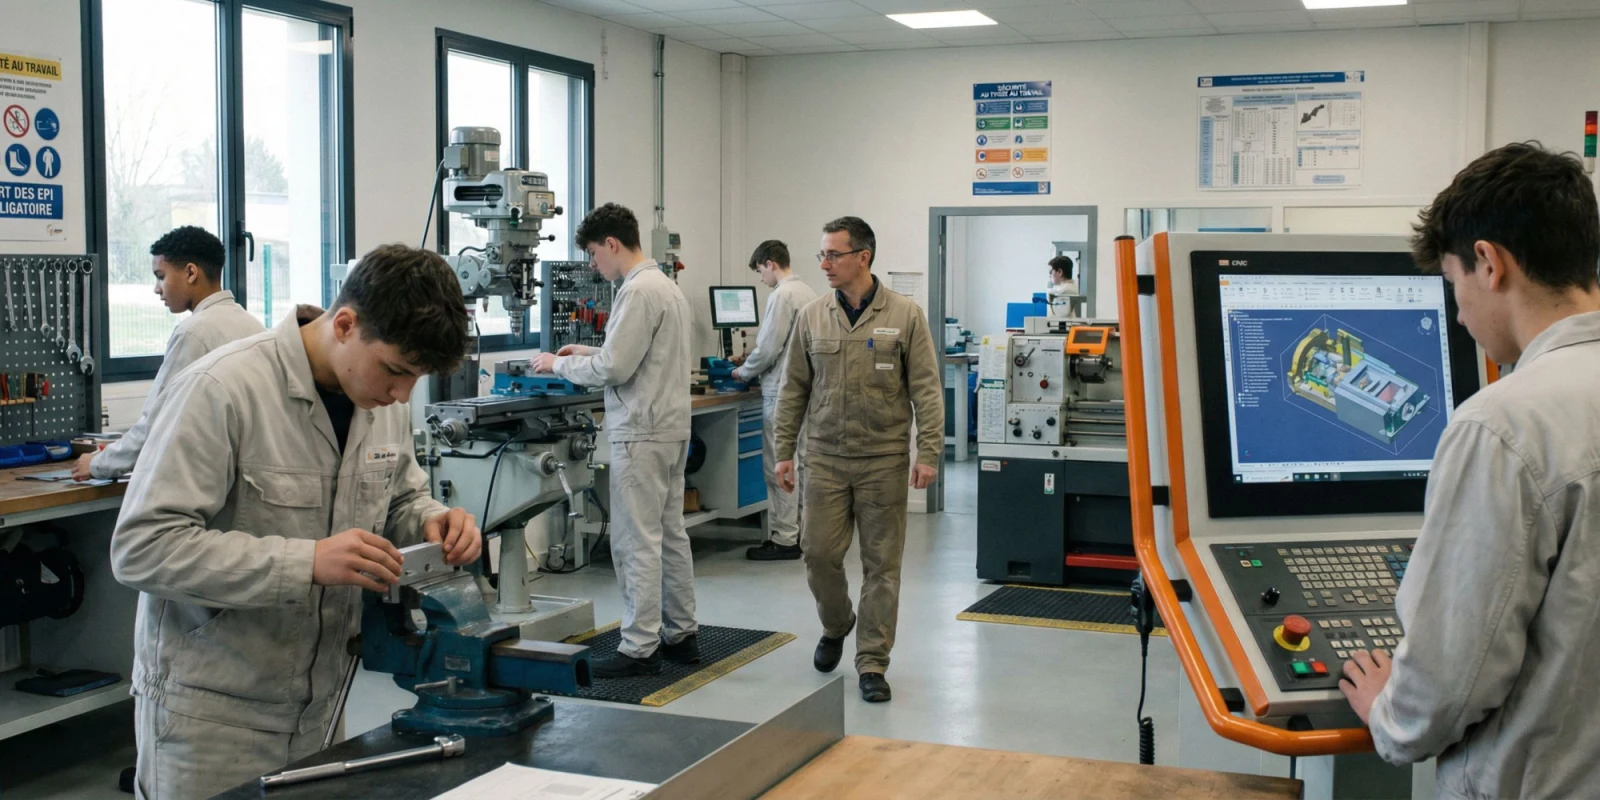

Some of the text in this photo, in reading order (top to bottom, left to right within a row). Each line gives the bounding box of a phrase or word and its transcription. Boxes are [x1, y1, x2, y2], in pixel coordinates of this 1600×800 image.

[12, 60, 23, 71] AU
[26, 62, 58, 76] TRAVAIL
[14, 186, 35, 200] DES
[38, 188, 53, 200] EPI
[0, 201, 53, 215] LIGATOIRE
